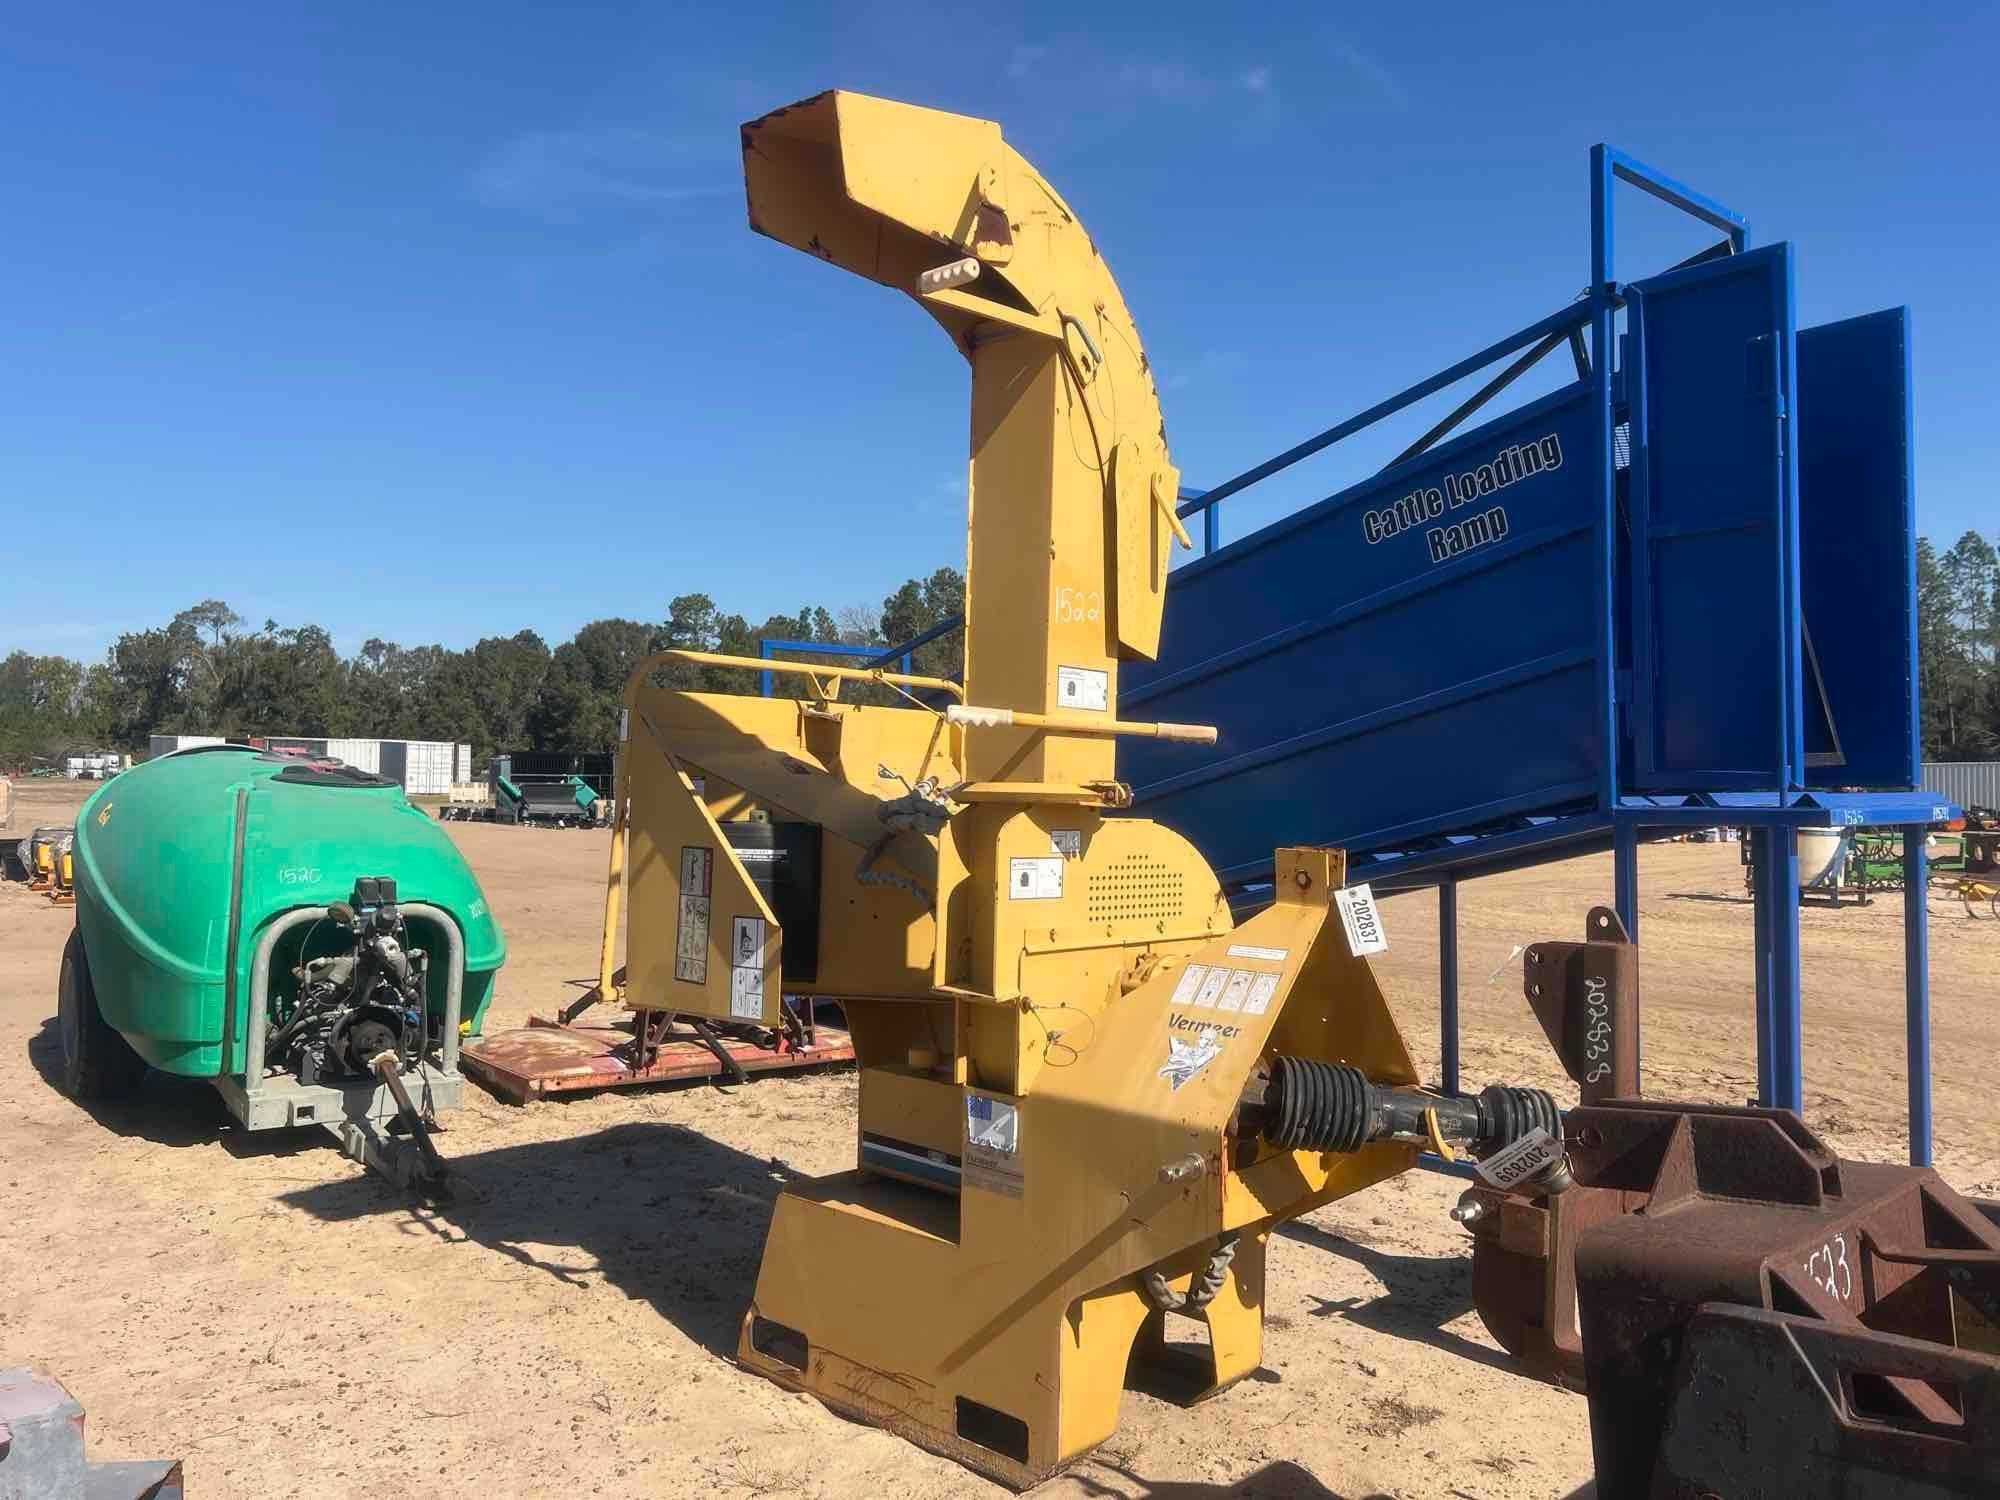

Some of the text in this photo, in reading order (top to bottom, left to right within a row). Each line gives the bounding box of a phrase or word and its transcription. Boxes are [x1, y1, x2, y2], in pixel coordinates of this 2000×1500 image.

[1363, 433, 1564, 544] Cattle Loading
[1426, 505, 1508, 563] Ramp
[1055, 587, 1102, 624] 1522
[1352, 899, 1380, 944] 202837
[1168, 1013, 1242, 1039] Vermeer
[1584, 976, 1612, 1083] 202838
[1495, 1145, 1550, 1183] 202839
